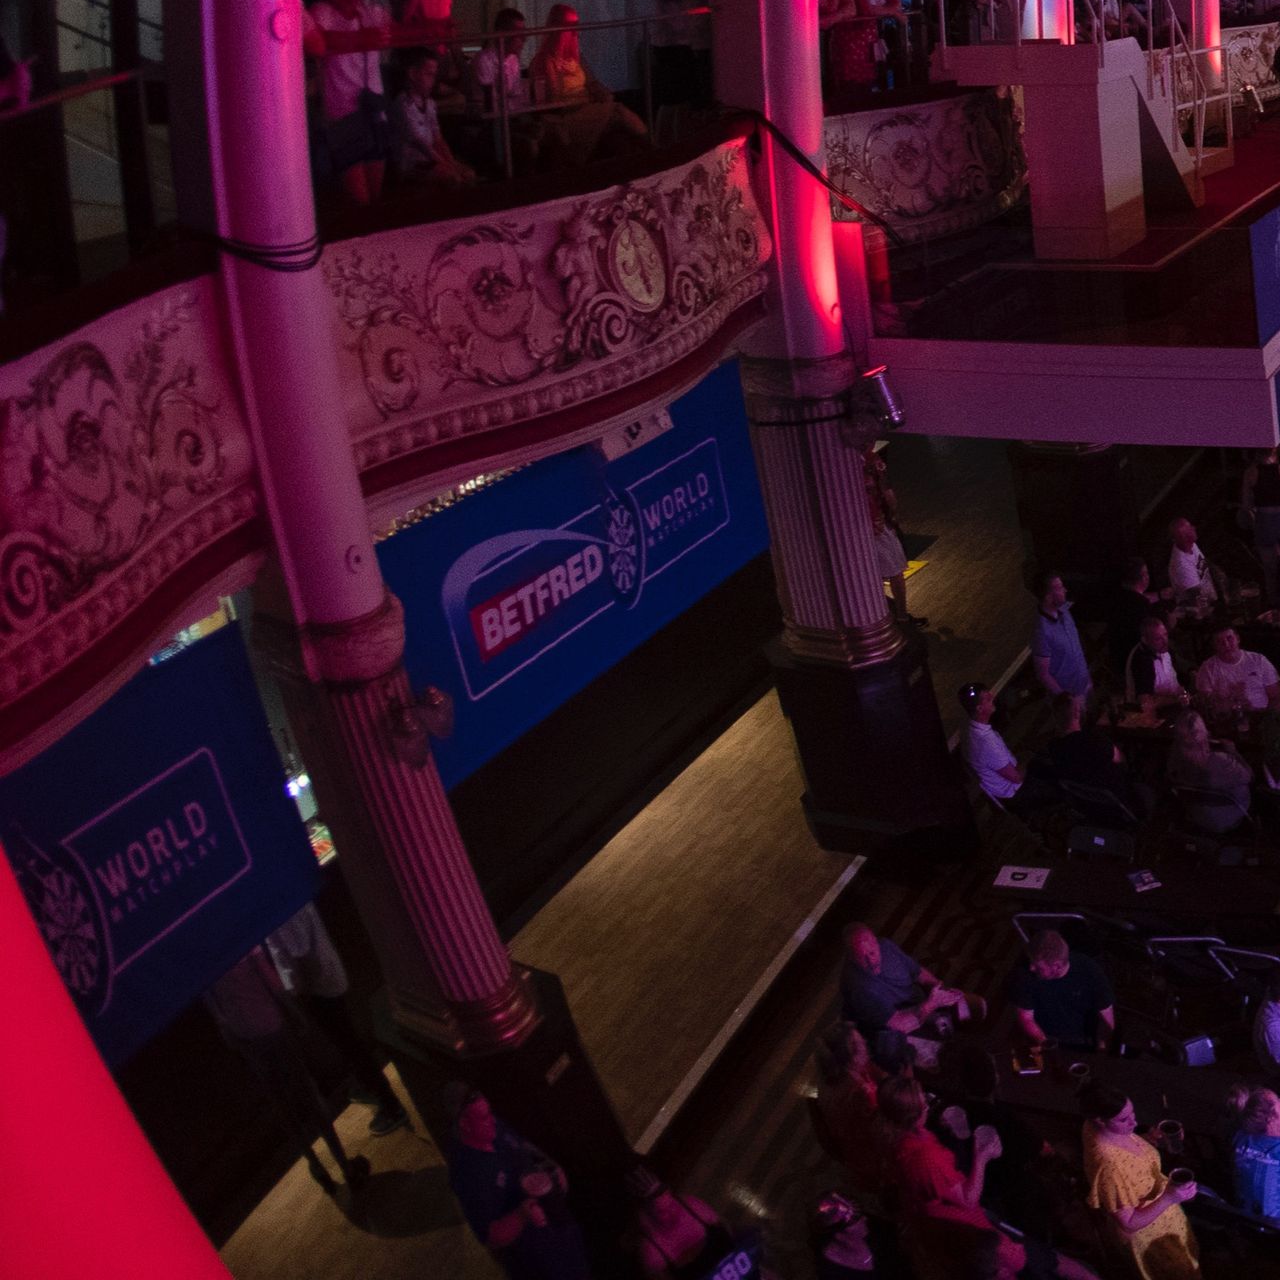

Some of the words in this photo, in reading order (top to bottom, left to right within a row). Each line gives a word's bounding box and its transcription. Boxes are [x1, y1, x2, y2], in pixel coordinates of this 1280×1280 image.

[480, 543, 605, 653] BETFRED
[644, 471, 709, 531] WORLD
[97, 801, 209, 898] WORLD
[109, 832, 221, 923] MATCHPLAY
